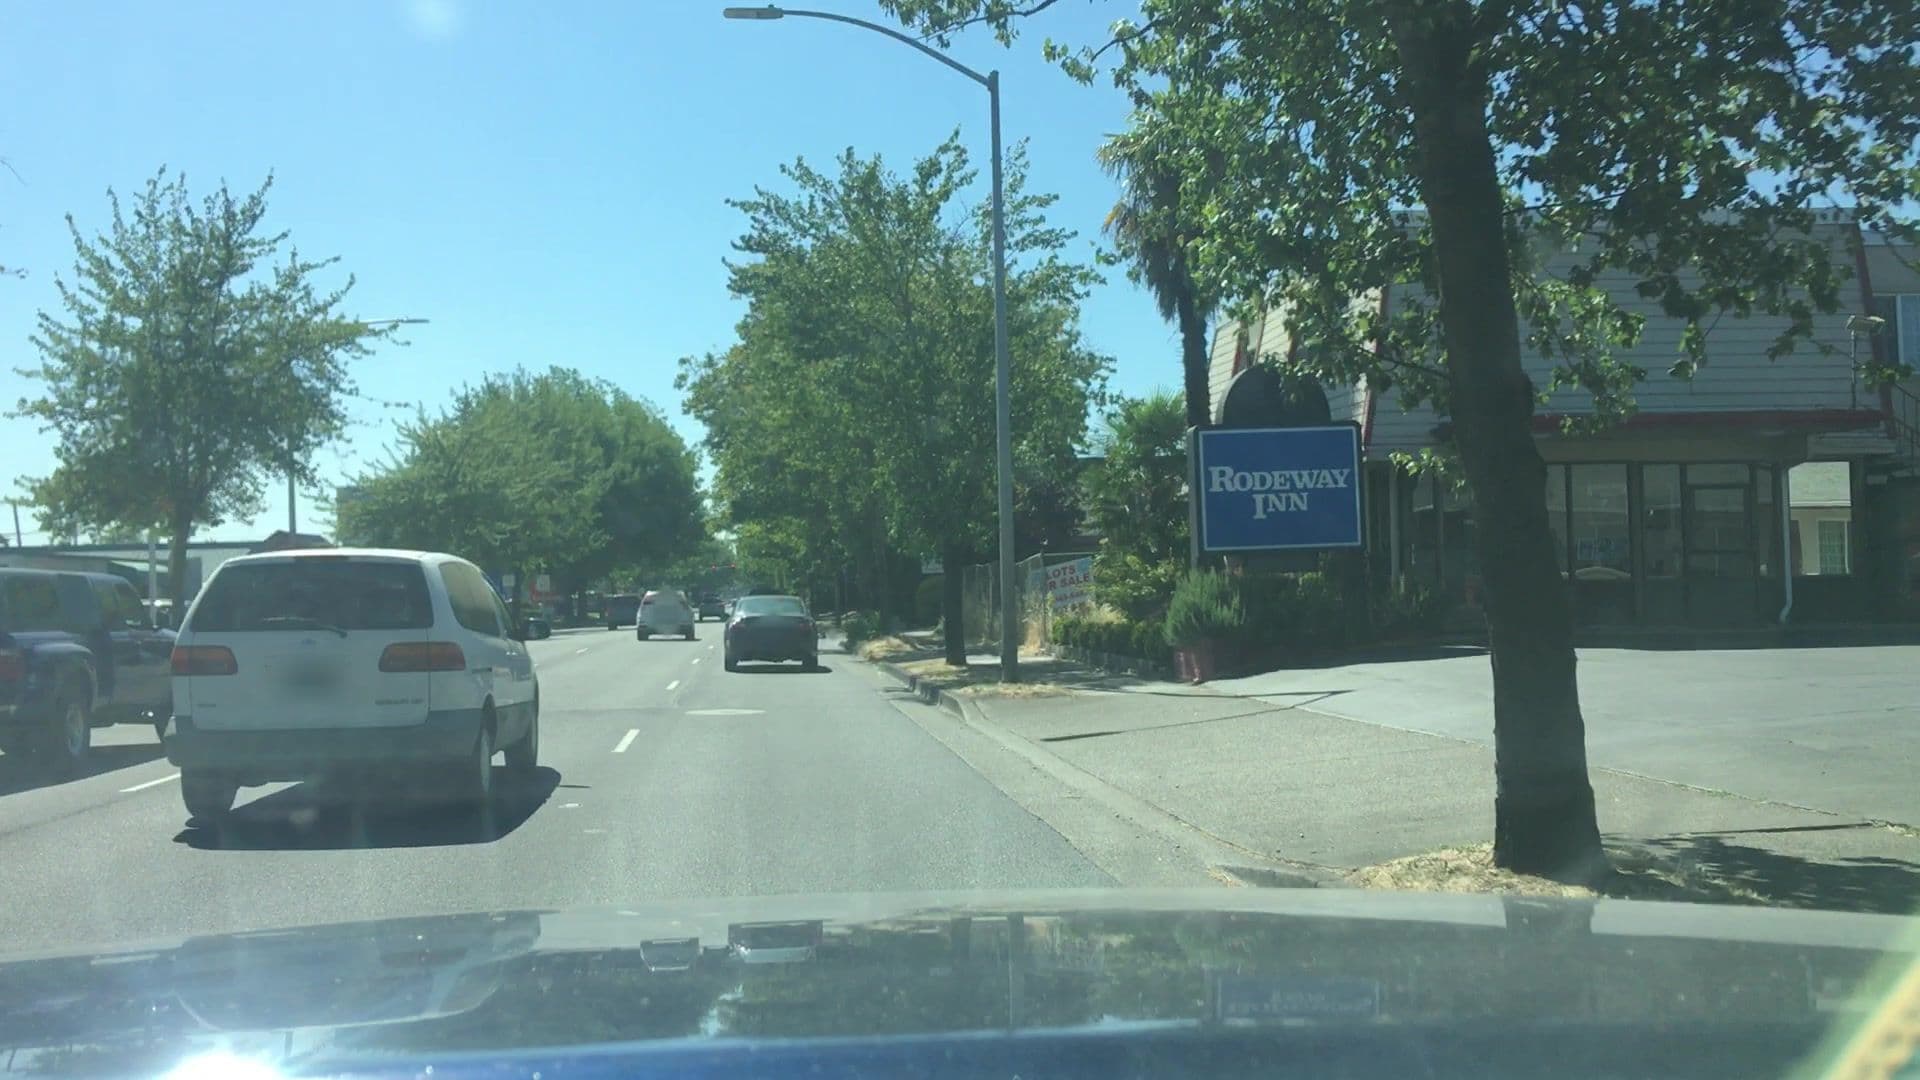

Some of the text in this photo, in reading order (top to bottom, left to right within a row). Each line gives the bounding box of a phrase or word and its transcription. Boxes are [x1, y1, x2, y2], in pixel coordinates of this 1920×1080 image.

[1208, 466, 1350, 492] RODEWAY
[1252, 493, 1309, 519] INN
[1060, 573, 1089, 588] SALE
